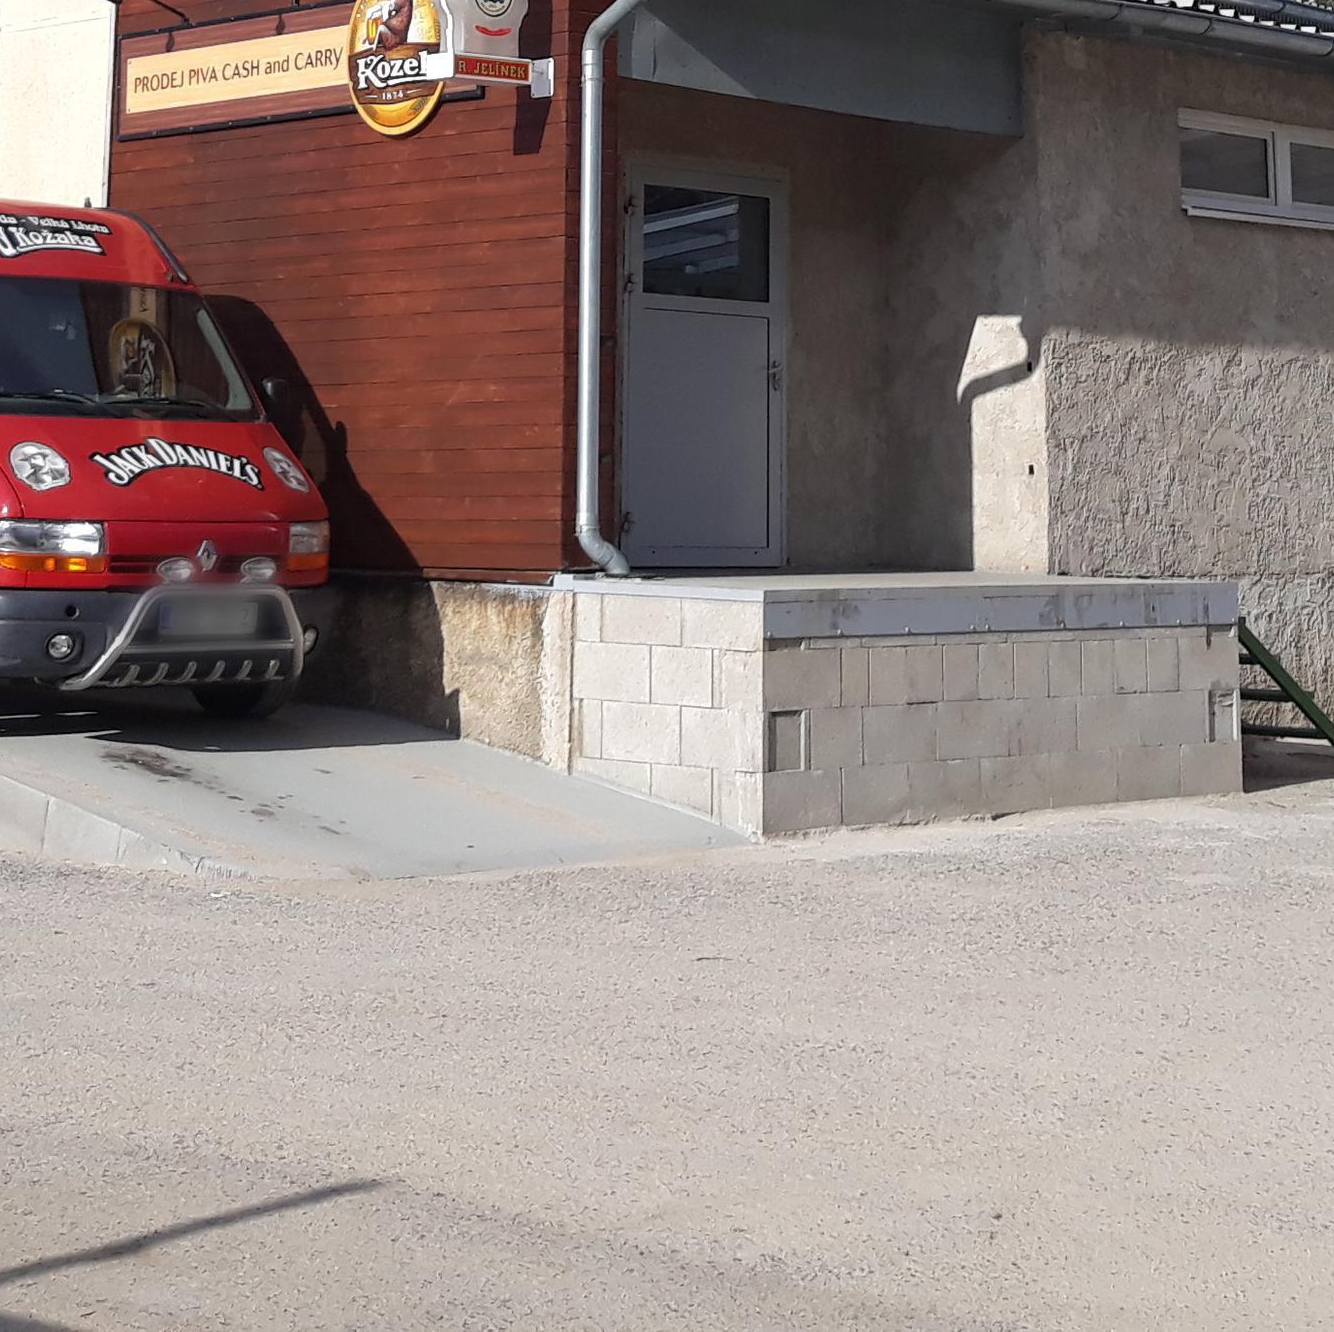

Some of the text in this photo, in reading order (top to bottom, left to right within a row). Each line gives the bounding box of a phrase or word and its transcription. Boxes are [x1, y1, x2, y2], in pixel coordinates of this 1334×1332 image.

[134, 47, 344, 94] PRODEJ PIVA CASH and CARRY
[356, 50, 429, 90] Kozel
[458, 60, 526, 79] R. JELÍNEK
[382, 90, 404, 100] 1874
[27, 216, 70, 229] Velká
[71, 220, 110, 234] Lhota
[8, 226, 99, 248] Kožaka
[93, 438, 260, 486] JACK DANIEL'S
